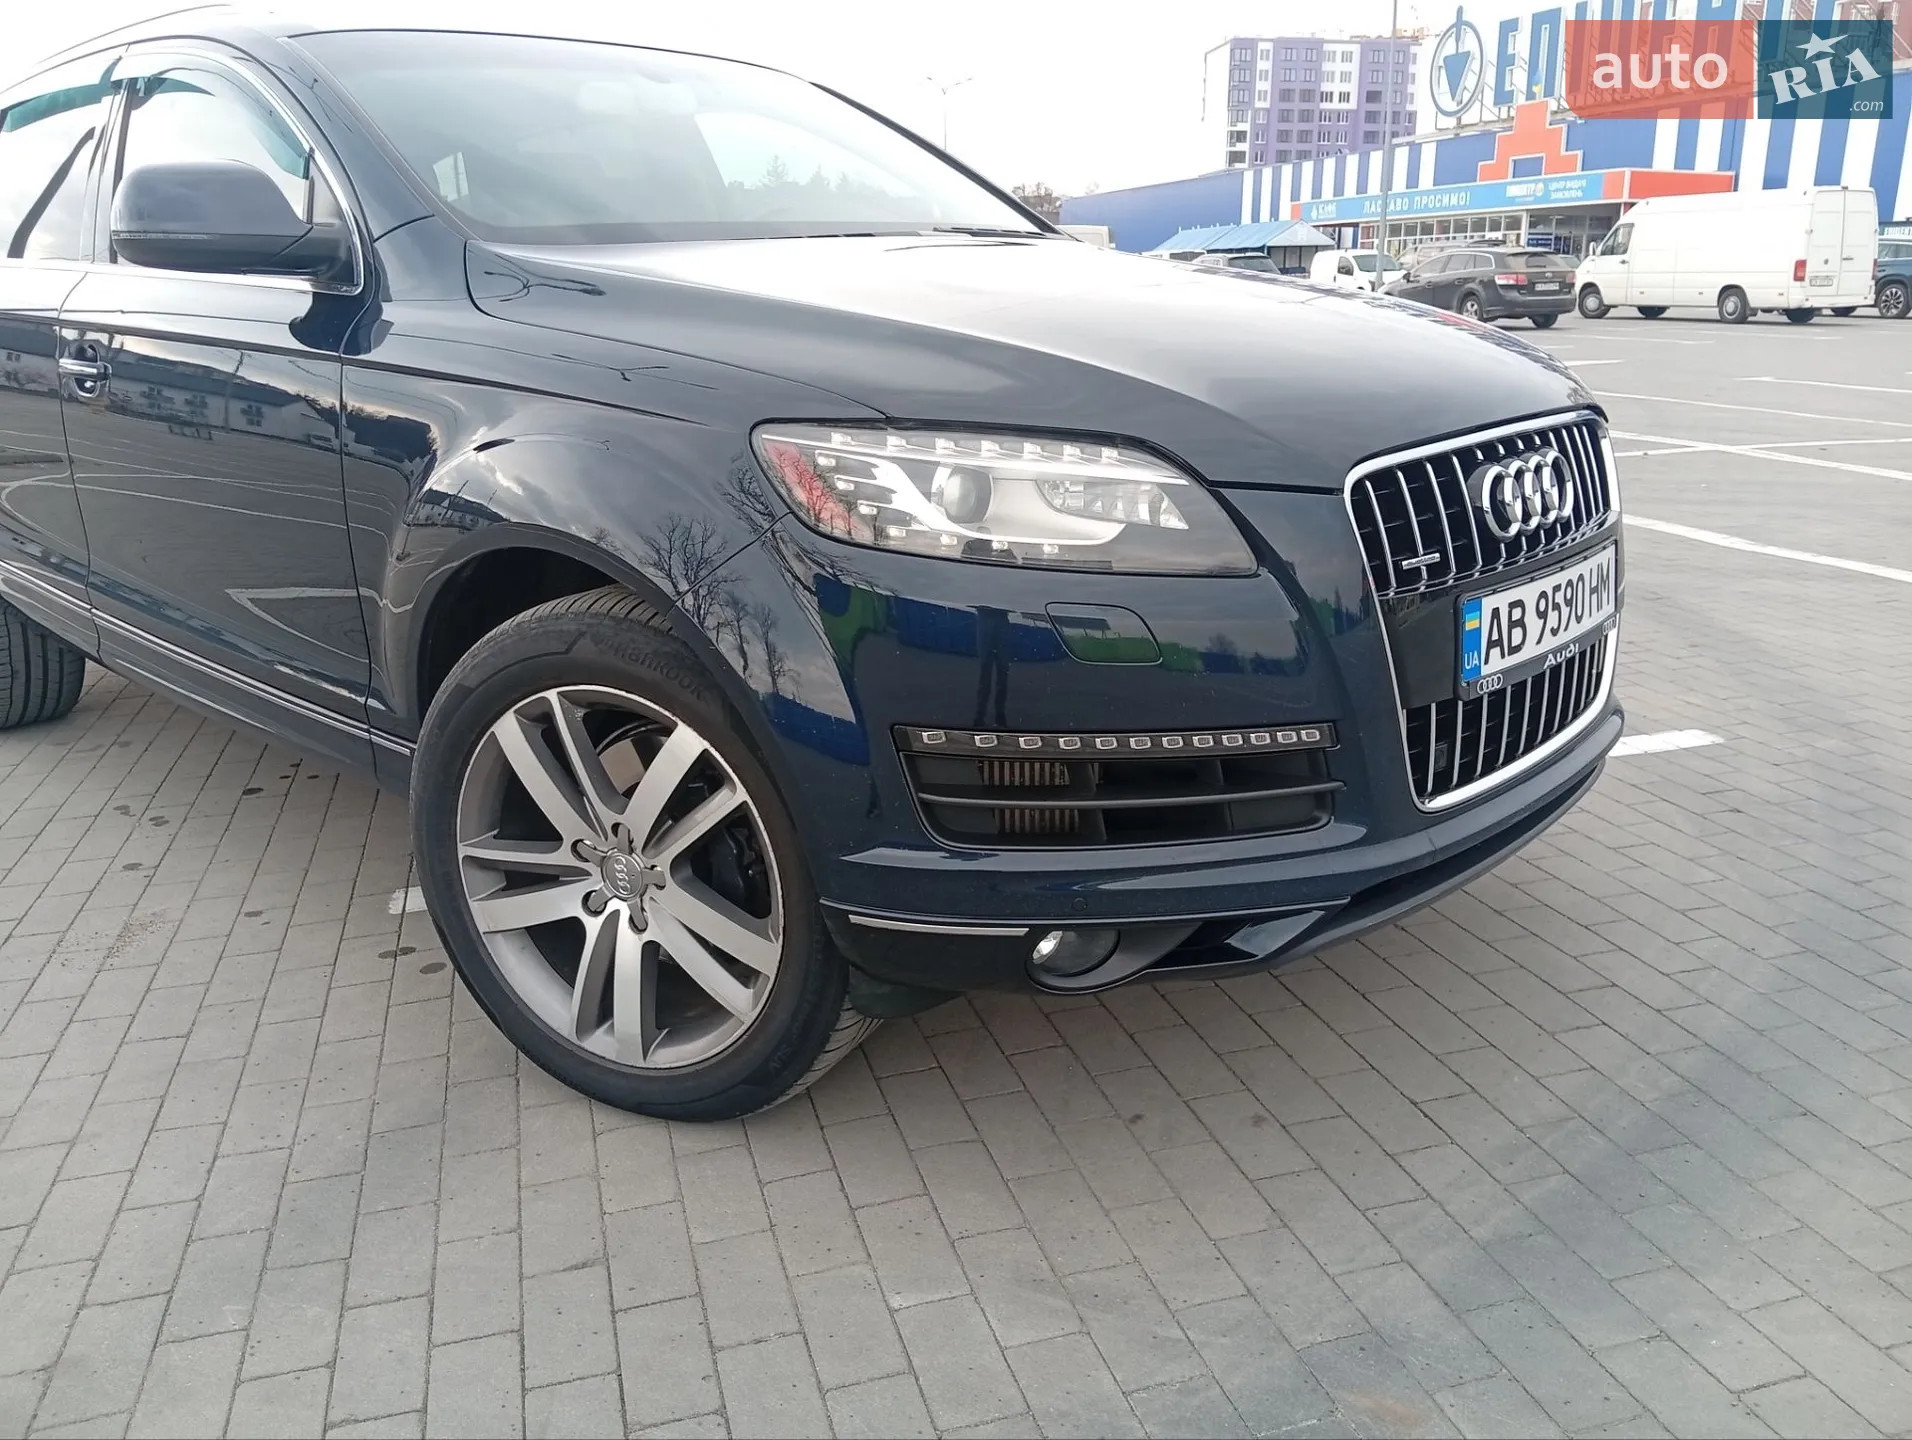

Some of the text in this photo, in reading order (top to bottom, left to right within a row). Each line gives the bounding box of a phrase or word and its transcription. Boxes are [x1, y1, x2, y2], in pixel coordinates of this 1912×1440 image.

[1413, 191, 1471, 210] ПРОСИМО!
[1483, 557, 1611, 666] AB 9590 HM
[1464, 650, 1480, 669] UA
[1543, 642, 1580, 669] Audi
